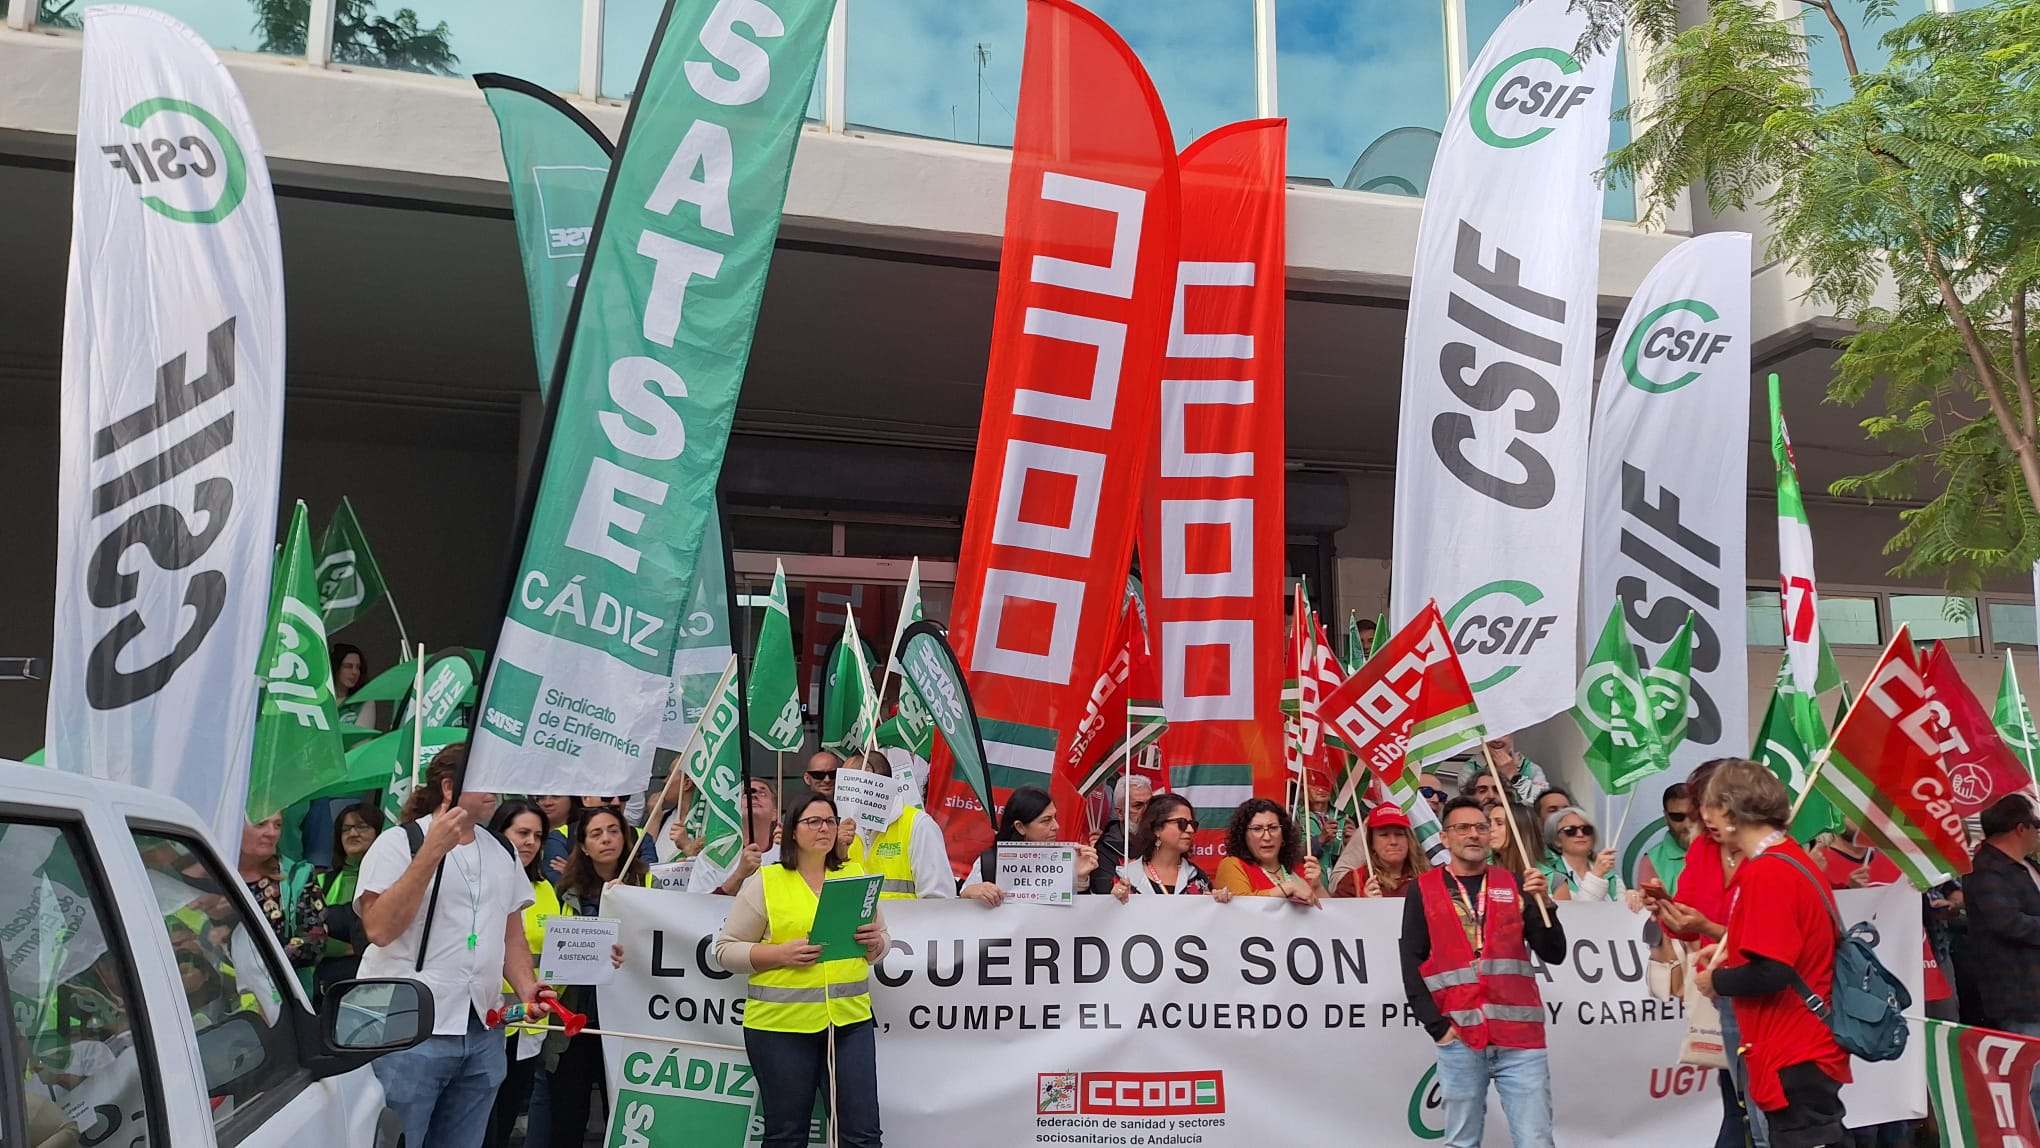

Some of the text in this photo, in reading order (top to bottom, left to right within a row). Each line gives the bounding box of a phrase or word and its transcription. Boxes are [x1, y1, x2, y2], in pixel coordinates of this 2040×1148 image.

[1494, 75, 1595, 119] CSIF
[565, 0, 785, 574] SATSE
[1643, 327, 1731, 365] CSIF
[1432, 218, 1566, 510] CSIF
[1161, 261, 1255, 723] CCOO
[521, 570, 664, 657] CÁDIZ
[1454, 614, 1558, 656] CSIF
[267, 622, 330, 731] CSIF
[486, 707, 525, 737] SATSE
[544, 688, 617, 724] Sindicato
[533, 730, 581, 758] Cádiz
[538, 709, 640, 758] de Enfermería
[850, 796, 887, 810] COLGADOS
[875, 792, 890, 801] NOS
[861, 813, 886, 825] SATSE
[672, 877, 685, 887] AL
[1002, 864, 1064, 874] NO AL ROBO
[1013, 878, 1054, 887] DEL CRP
[860, 879, 880, 919] SATSE
[550, 927, 570, 935] FALTA
[652, 930, 735, 980] LO
[874, 934, 1210, 989] CUERDOS
[1240, 936, 1369, 987] SON
[908, 1003, 1061, 1031] CUMPLE
[1079, 1003, 1122, 1030] EL
[1137, 1002, 1309, 1031] ACUERDO
[1324, 1002, 1366, 1030] DE
[1548, 1002, 1563, 1025] Y
[623, 1048, 755, 1099] CÁDIZ
[1650, 1065, 1712, 1099] UGT
[1088, 1080, 1192, 1108] CCOO
[1036, 1117, 1226, 1131] federación de sanidad y sectores
[1036, 1132, 1202, 1145] sociosanitarios de Andalucía
